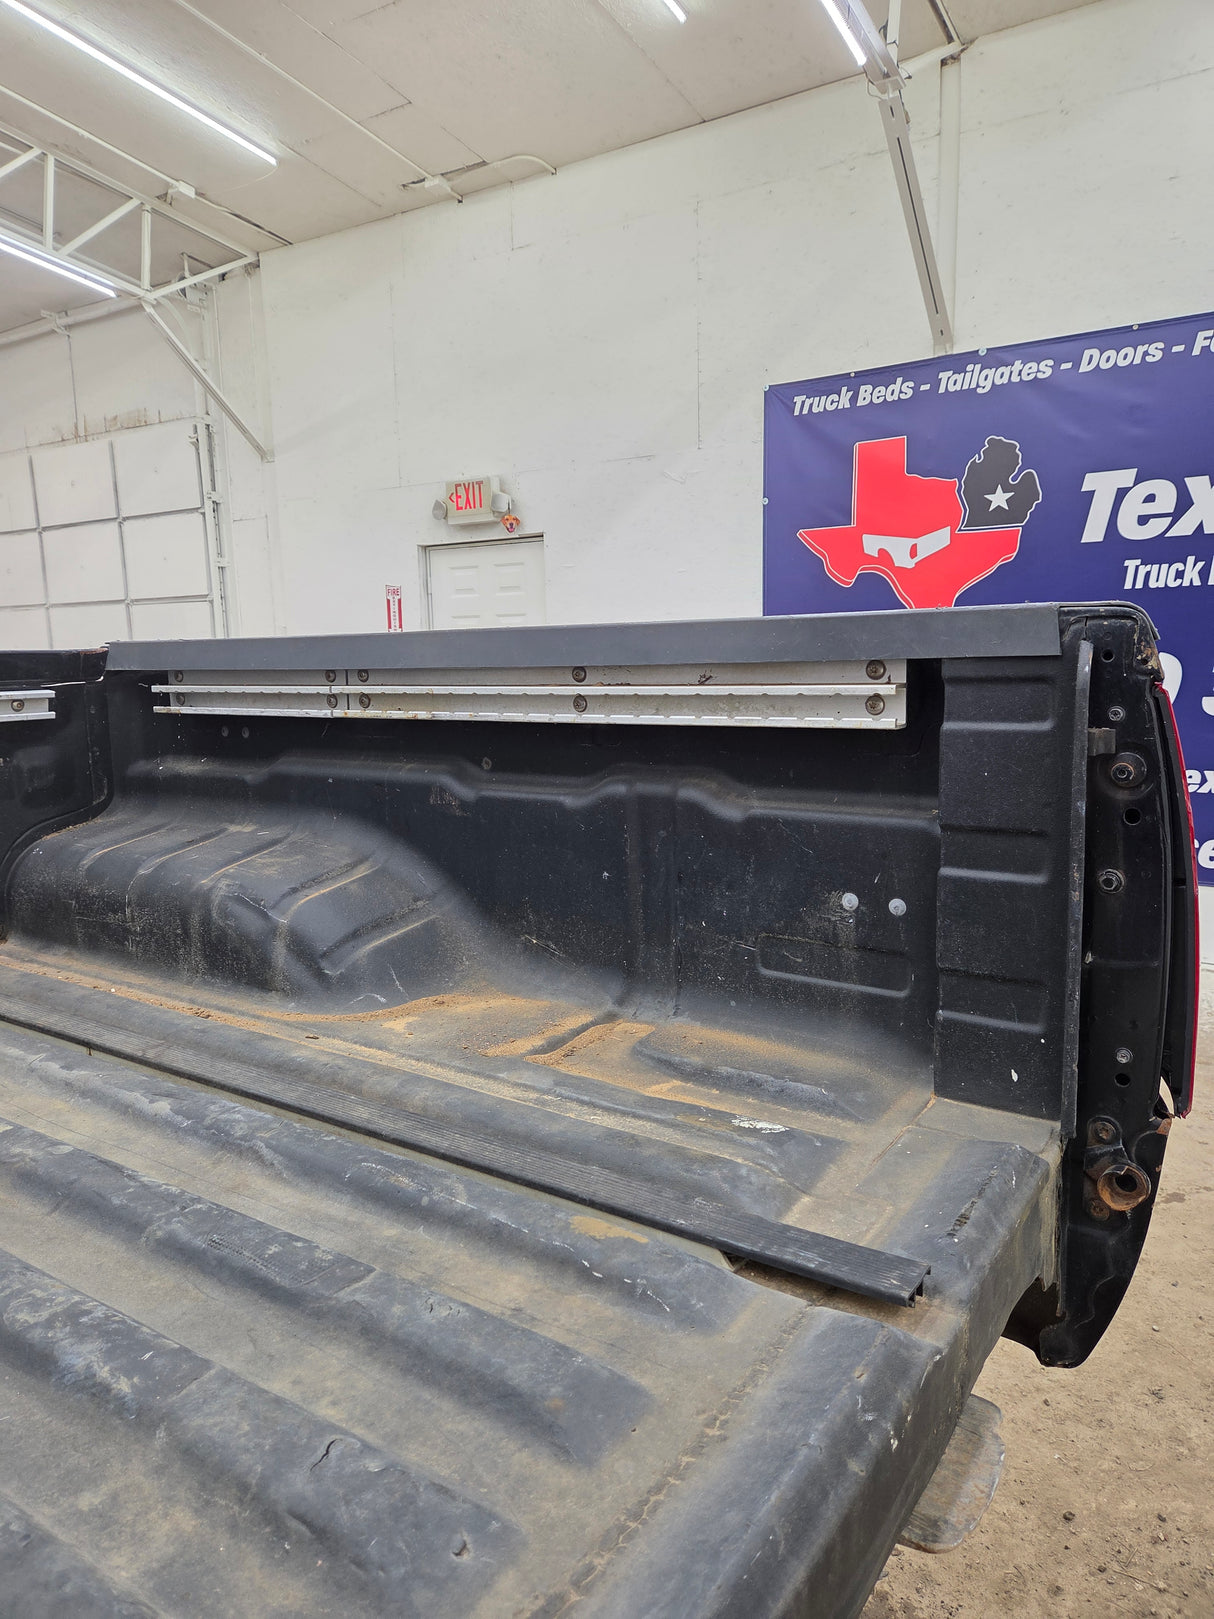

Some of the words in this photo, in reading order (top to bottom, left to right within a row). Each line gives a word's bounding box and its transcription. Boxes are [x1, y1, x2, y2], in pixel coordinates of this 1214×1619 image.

[793, 386, 854, 416] Truck
[856, 377, 915, 407] Beds
[938, 359, 1054, 394] Tailgates
[1078, 341, 1165, 373] Doors
[1191, 329, 1214, 356] F
[455, 480, 483, 511] EXIT
[1080, 467, 1214, 543] Tex
[1123, 555, 1206, 590] Truck
[387, 588, 400, 596] FIRE
[1186, 769, 1214, 794] ex
